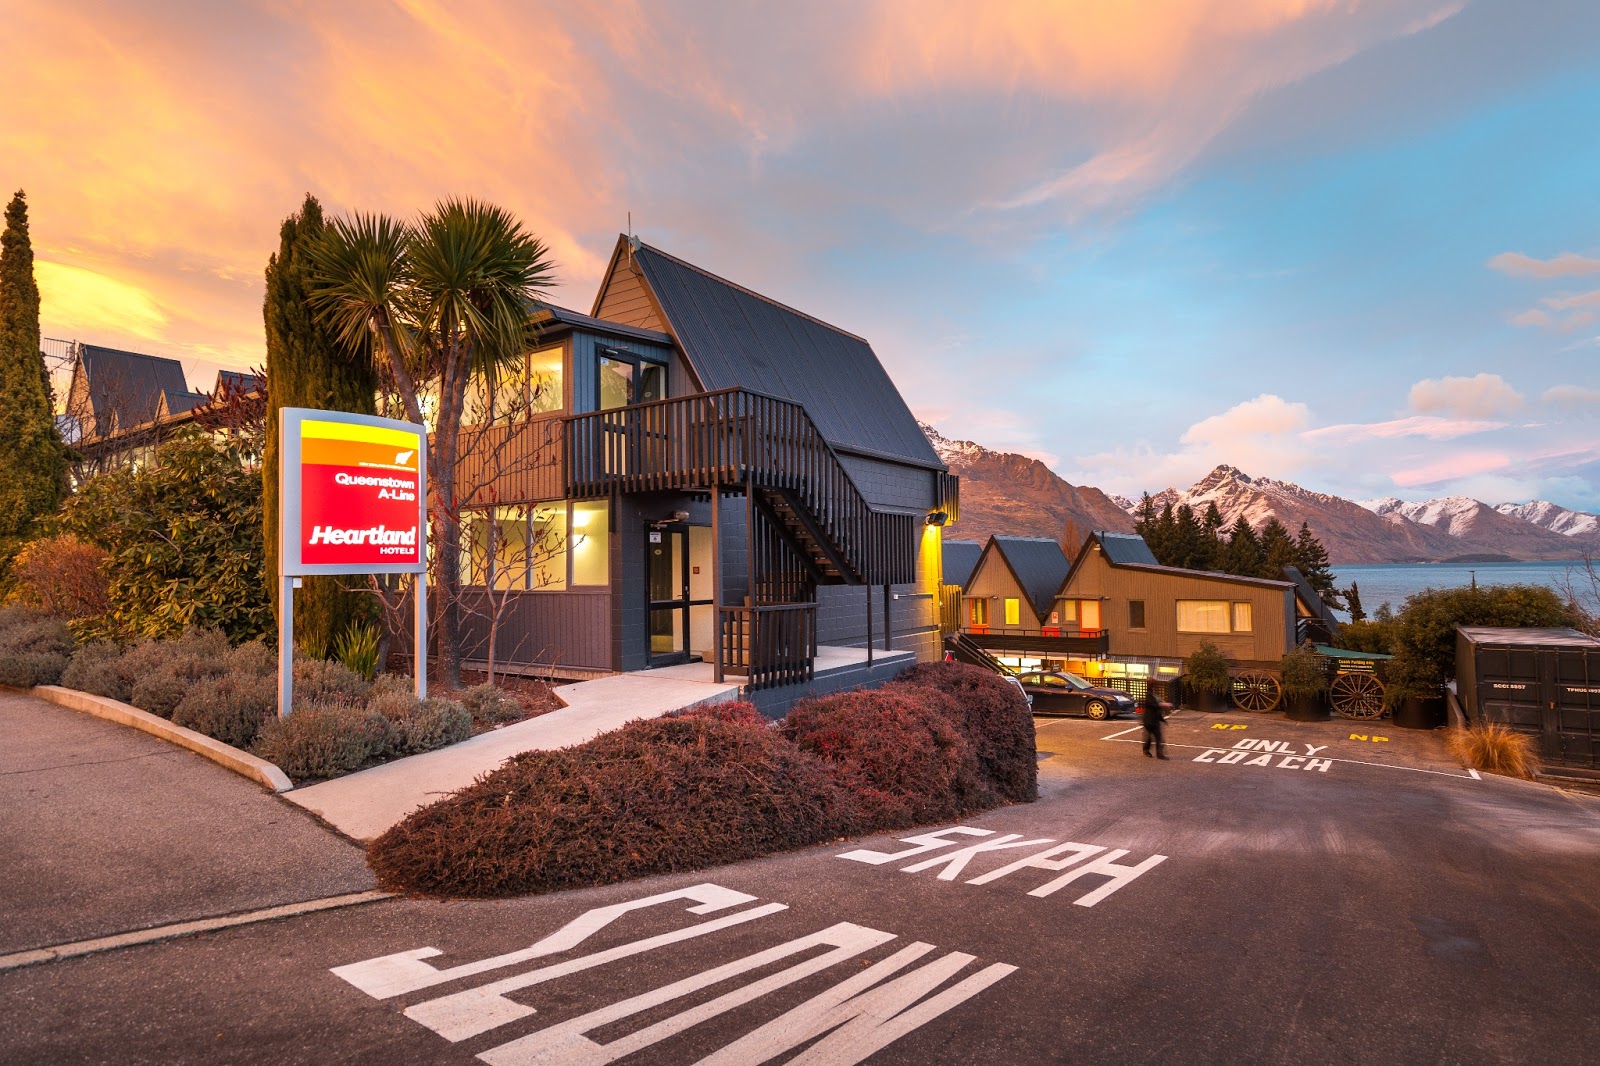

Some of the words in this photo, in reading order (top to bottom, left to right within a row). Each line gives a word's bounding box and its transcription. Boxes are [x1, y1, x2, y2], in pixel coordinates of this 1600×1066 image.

[335, 473, 415, 489] Queenstown
[378, 489, 415, 501] A-Line
[309, 525, 416, 545] Heartland
[380, 547, 415, 555] HOTELS
[1349, 733, 1389, 743] NP
[1232, 738, 1328, 756] ONLY
[1192, 749, 1333, 772] COACH
[329, 883, 1019, 1066] SLOW
